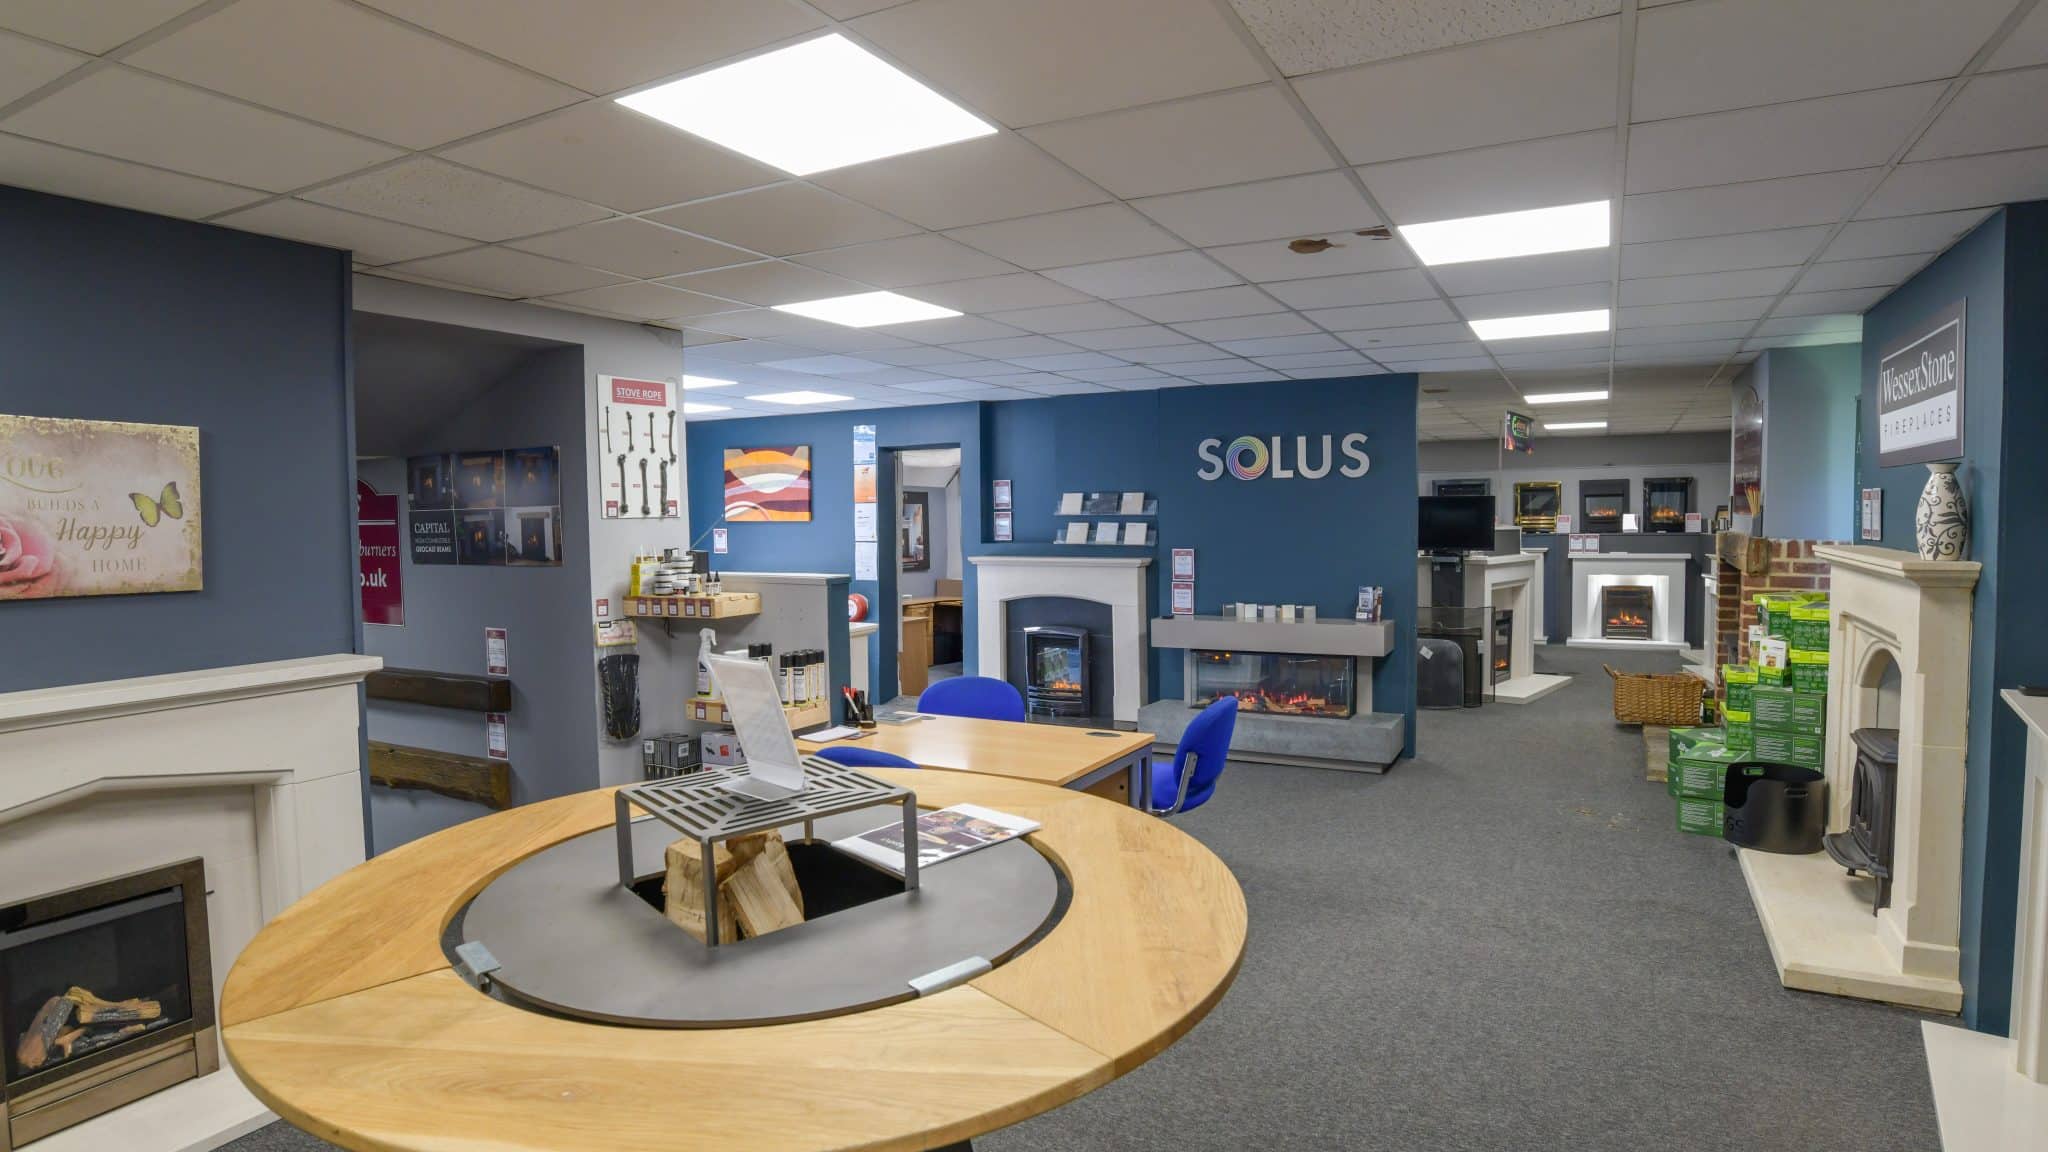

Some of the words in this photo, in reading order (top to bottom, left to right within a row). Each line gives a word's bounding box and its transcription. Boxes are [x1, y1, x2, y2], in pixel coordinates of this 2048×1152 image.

[616, 387, 640, 398] STOVE
[643, 390, 662, 401] ROPE
[1884, 404, 1952, 438] FIREPLACES
[1197, 432, 1370, 481] SOLUS
[27, 498, 85, 511] BUILDS
[92, 498, 101, 510] A
[56, 517, 144, 551] Happy
[414, 522, 450, 534] CAPITAL
[92, 558, 146, 573] HOME
